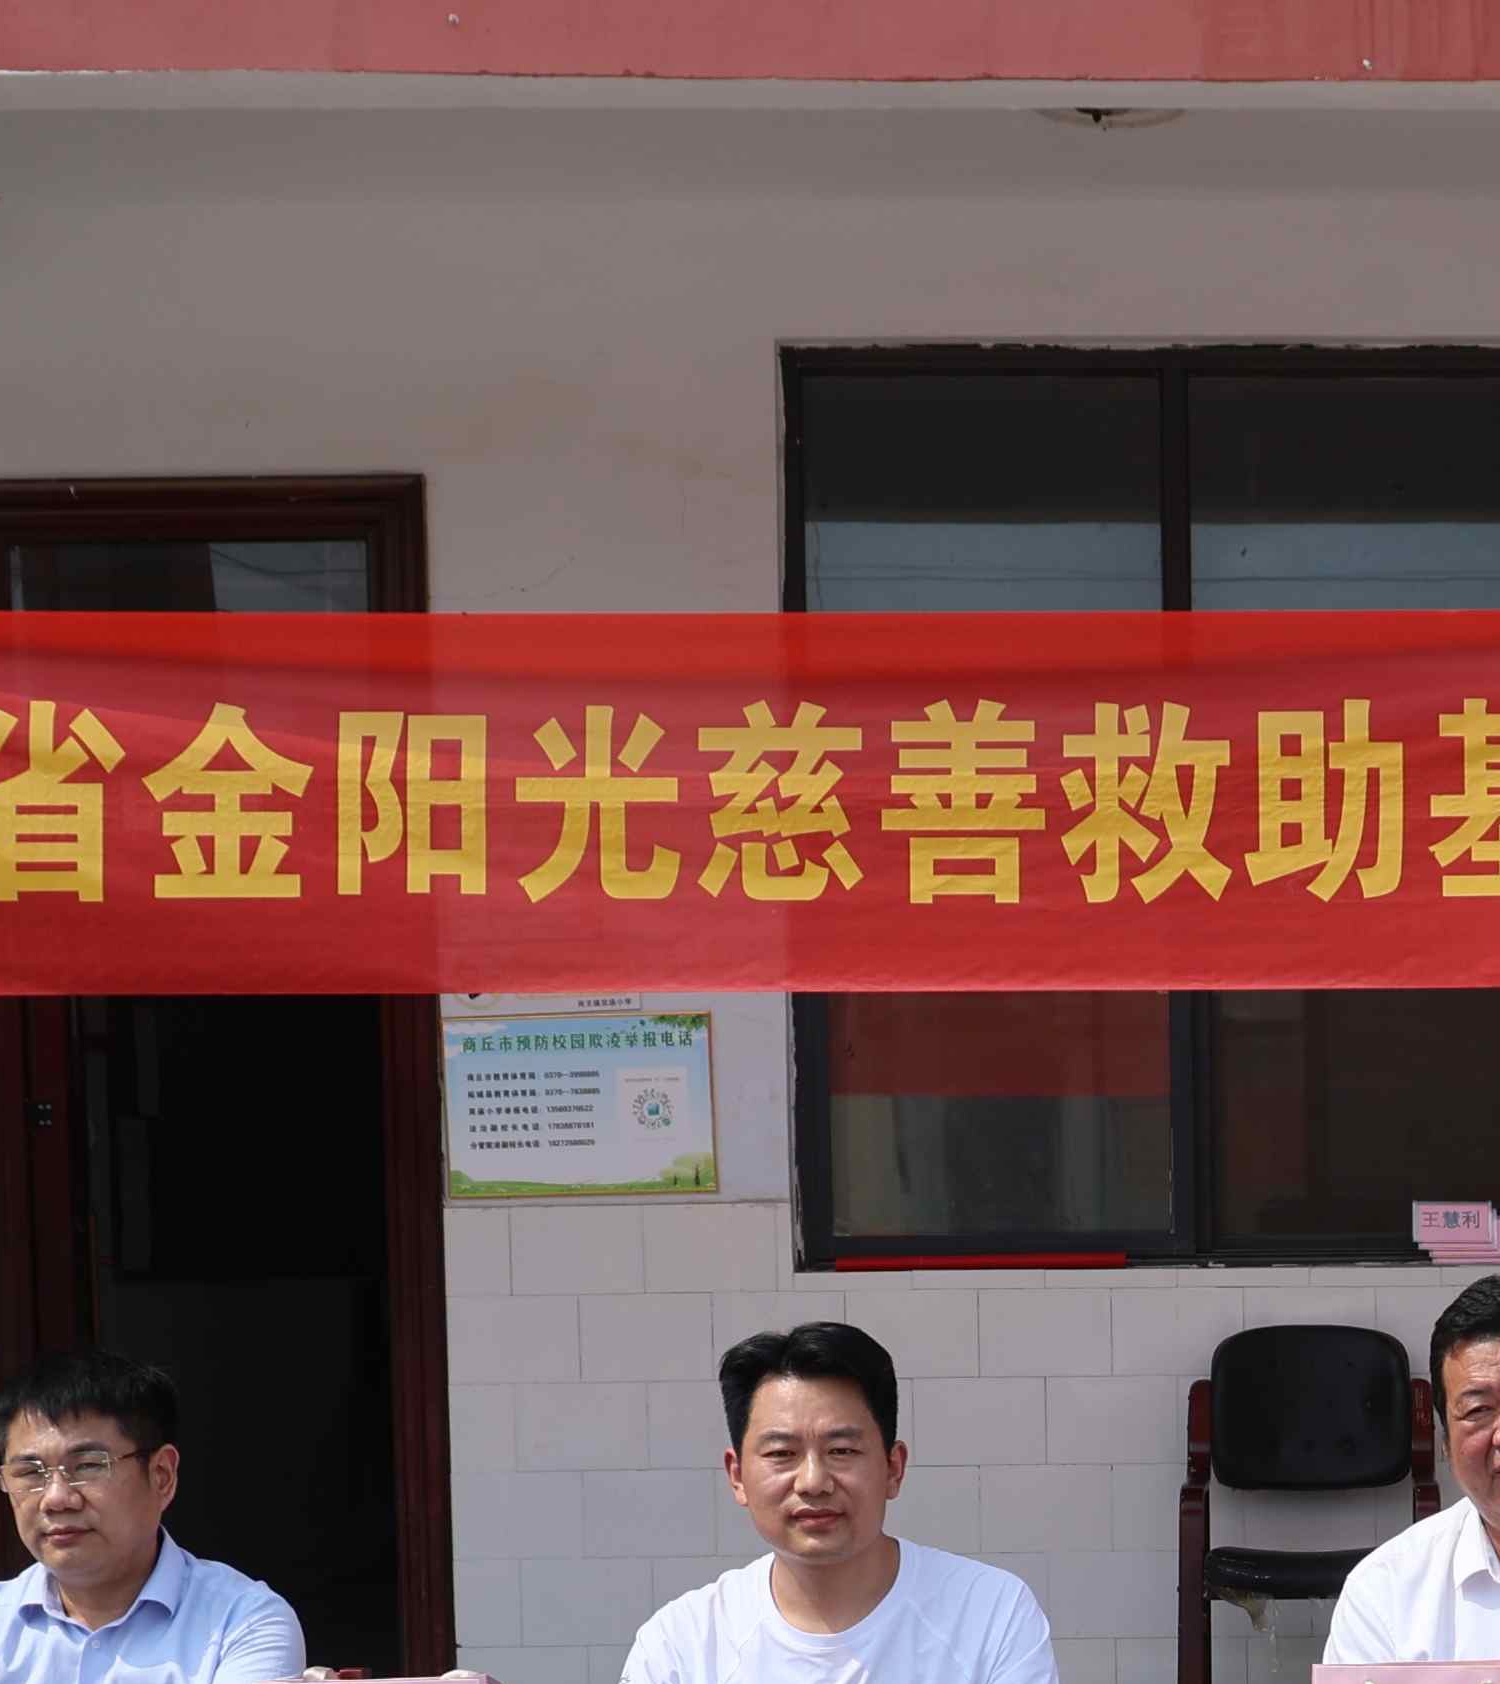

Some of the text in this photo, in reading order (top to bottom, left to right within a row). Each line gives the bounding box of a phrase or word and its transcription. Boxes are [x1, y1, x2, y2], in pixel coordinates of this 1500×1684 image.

[462, 1030, 694, 1054] 商丘市预防校园欺凌举报电话
[1424, 1211, 1479, 1228] 王慧利
